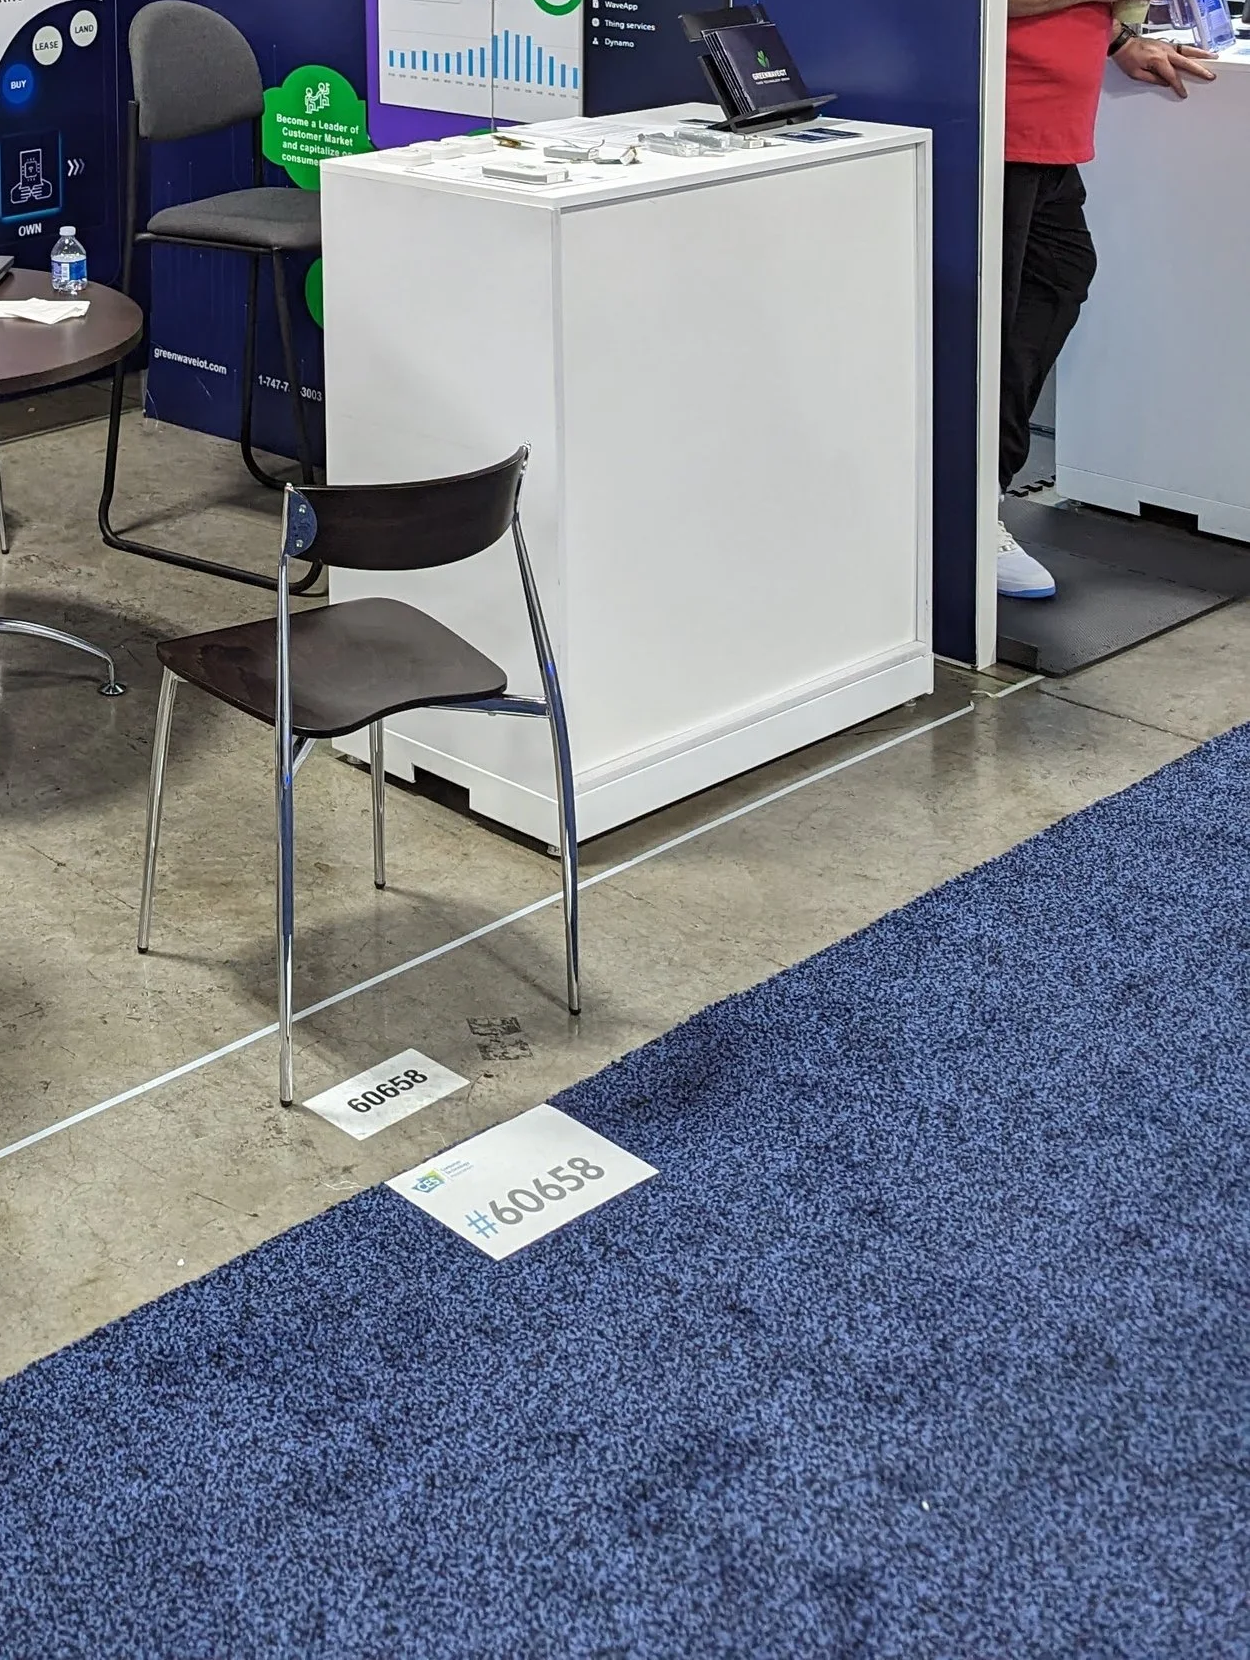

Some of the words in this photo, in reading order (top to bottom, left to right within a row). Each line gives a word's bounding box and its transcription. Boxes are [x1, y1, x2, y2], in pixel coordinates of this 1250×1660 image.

[605, 0, 639, 11] WaveApp
[74, 23, 95, 35] LAND
[604, 19, 625, 29] Thing
[626, 20, 656, 32] services
[34, 40, 59, 53] LEASE
[604, 38, 635, 48] Dynamo
[10, 79, 27, 91] BUY
[276, 113, 309, 127] Become
[318, 120, 347, 133] Leader
[350, 125, 359, 135] of
[282, 126, 322, 141] Customer
[324, 133, 353, 147] Market
[282, 141, 298, 150] and
[300, 144, 340, 157] capitalize
[18, 222, 42, 237] OWN
[154, 348, 227, 375] greenwaveiot.com
[347, 1069, 428, 1113] 60658
[465, 1157, 605, 1239] #60658
